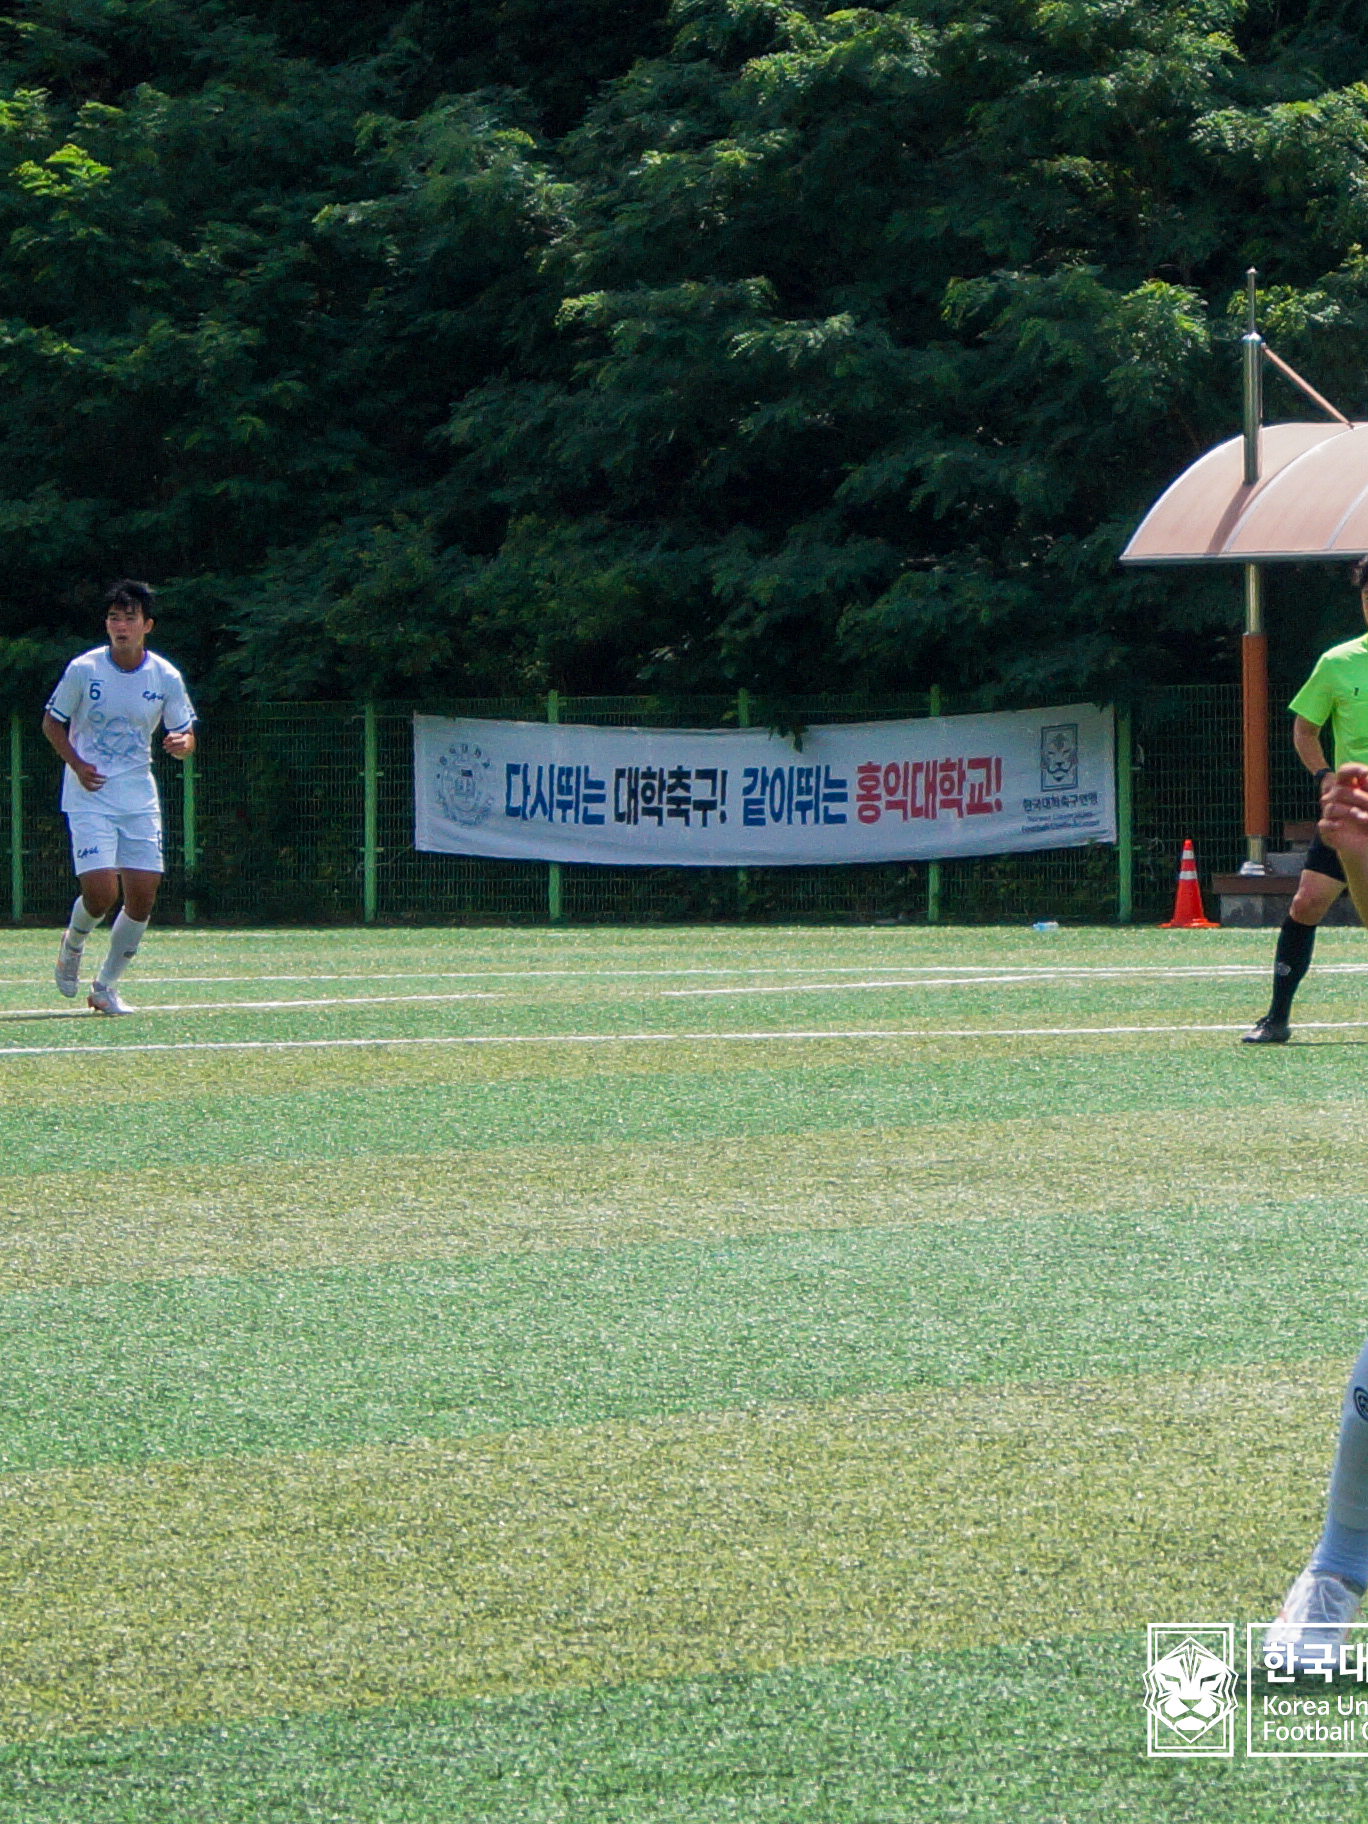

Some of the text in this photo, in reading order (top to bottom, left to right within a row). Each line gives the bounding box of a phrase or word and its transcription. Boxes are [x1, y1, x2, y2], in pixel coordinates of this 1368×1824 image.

[90, 682, 101, 700] 6
[505, 763, 606, 825] 다시뛰는
[613, 765, 728, 827] 대학축구!
[742, 764, 849, 827] 같이뛰는
[856, 757, 1003, 825] 홍익대학교!
